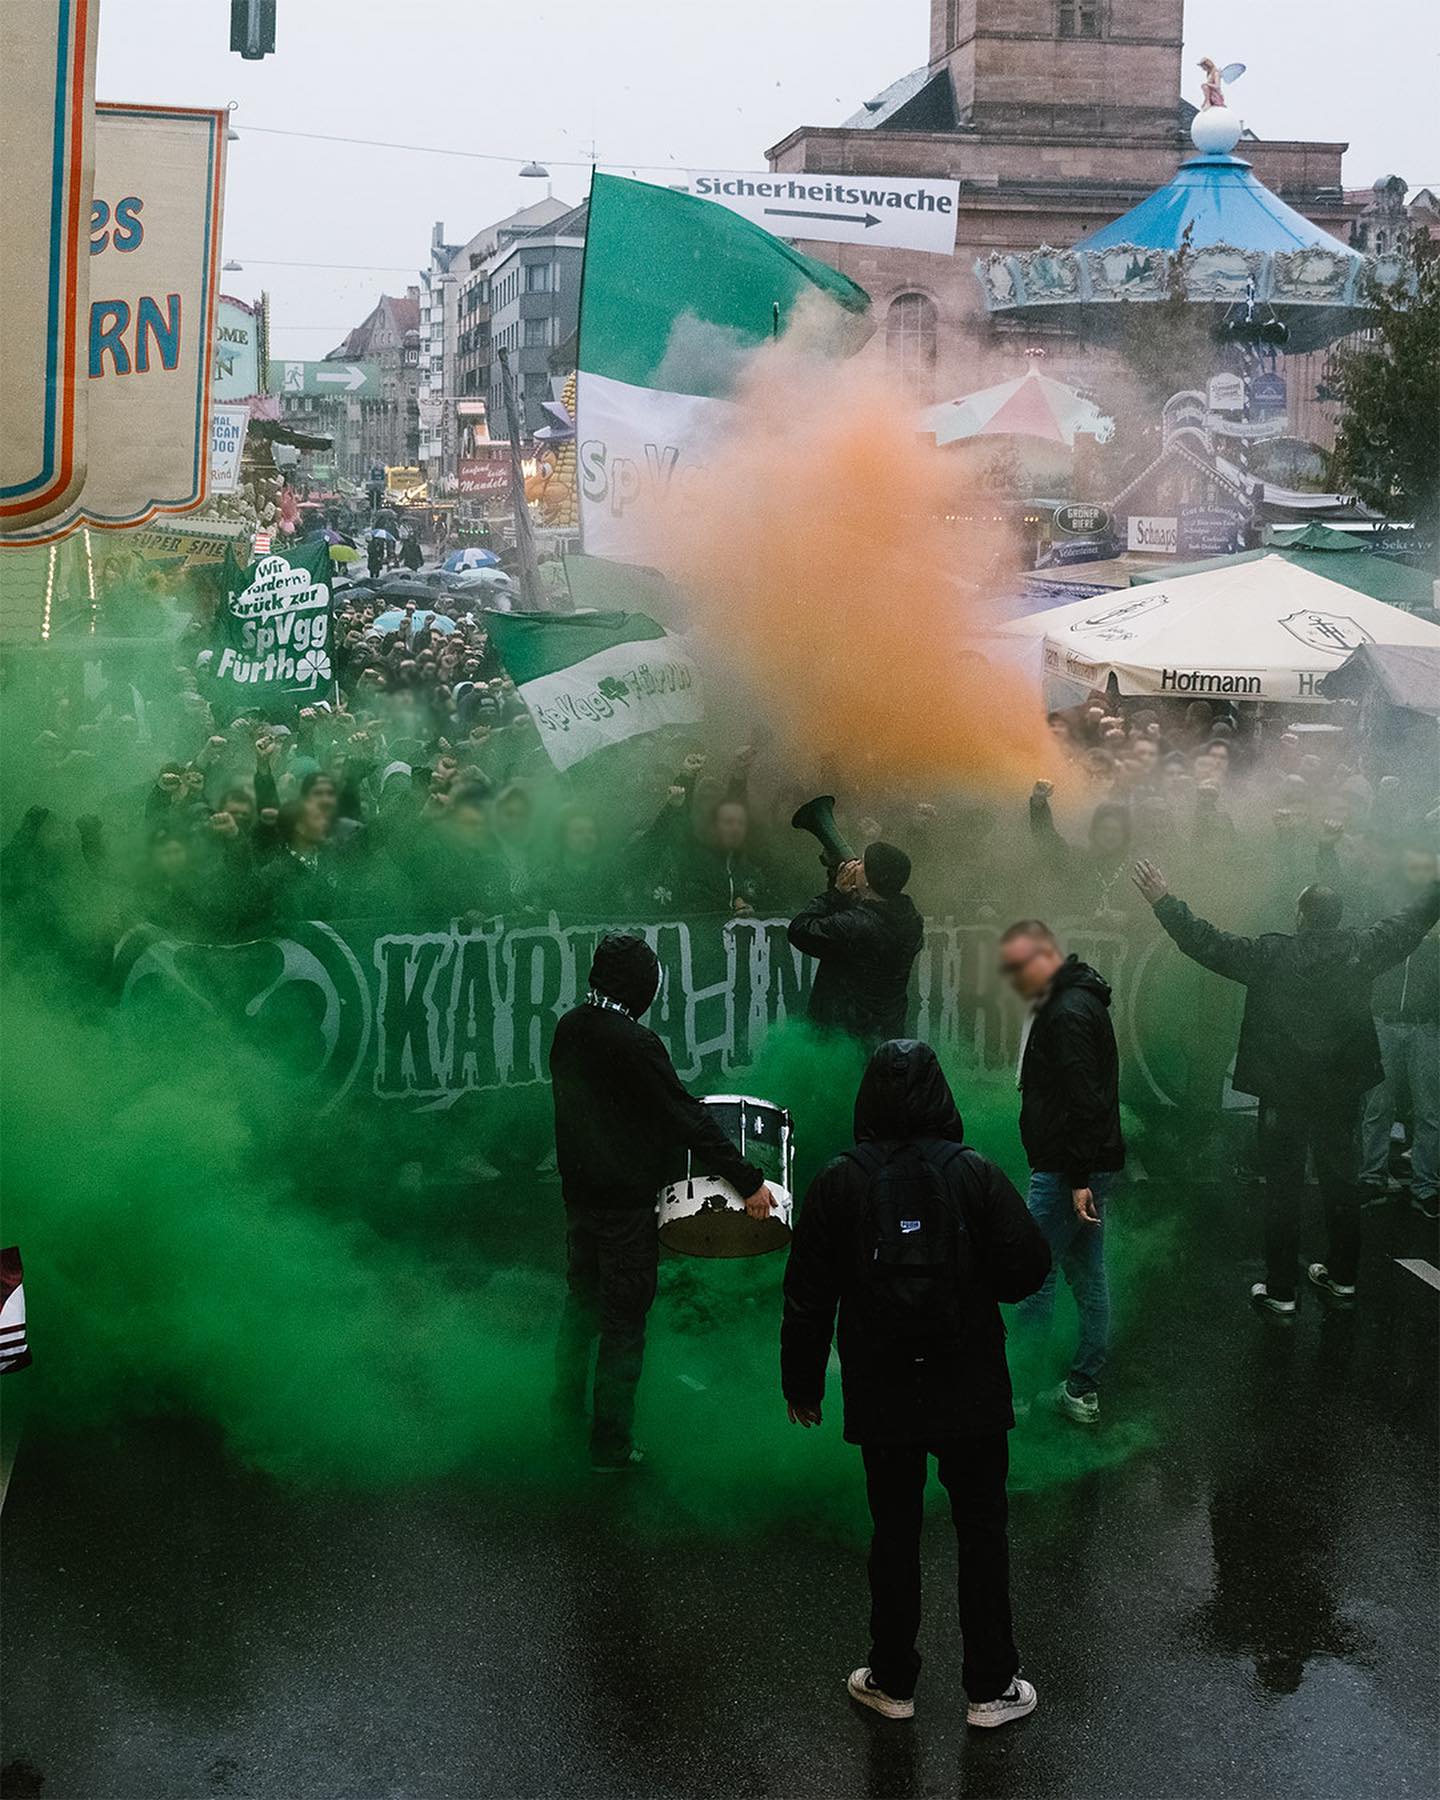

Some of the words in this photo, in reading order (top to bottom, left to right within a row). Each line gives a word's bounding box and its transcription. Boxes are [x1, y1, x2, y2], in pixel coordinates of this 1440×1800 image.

[696, 177, 952, 213] Sicherheitswache
[1072, 519, 1094, 529] BIERE
[1137, 520, 1177, 550] Schnaps
[259, 560, 285, 578] Wir
[290, 589, 318, 606] zur
[242, 612, 328, 657] SpVgg
[217, 648, 295, 683] Fürth
[1161, 669, 1262, 693] Hofmann
[535, 690, 614, 732] SpVgg
